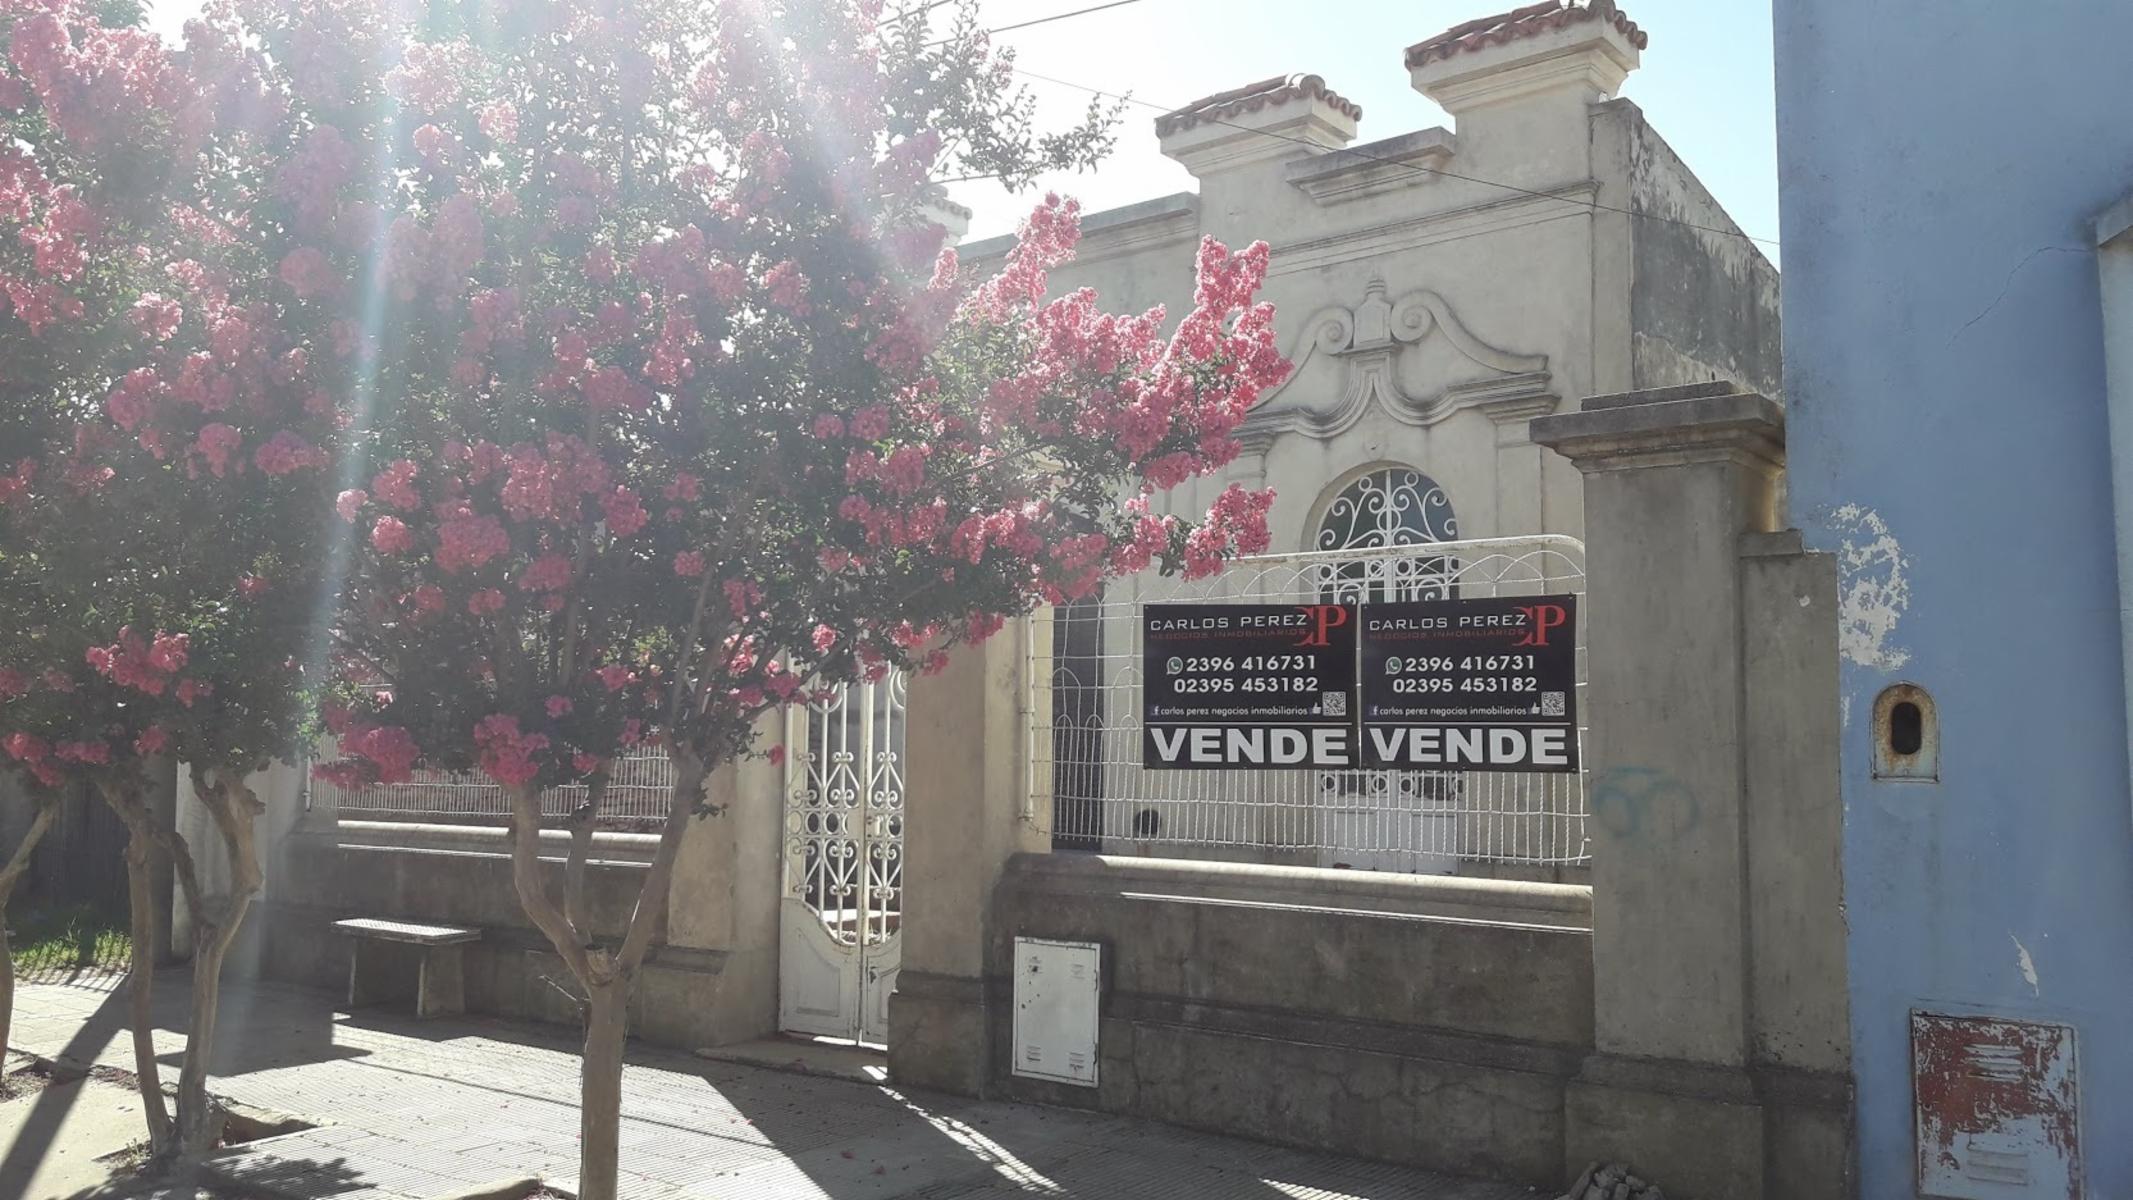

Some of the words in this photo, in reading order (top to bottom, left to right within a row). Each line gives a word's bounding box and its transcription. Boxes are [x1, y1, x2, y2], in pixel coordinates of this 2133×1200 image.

[1150, 617, 1229, 631] CARLOS
[1240, 614, 1307, 627] PEREZ
[1369, 617, 1448, 631] CARLOS
[1459, 614, 1526, 627] PEREZ
[1186, 656, 1235, 672] 2396
[1241, 655, 1316, 671] 416731
[1405, 656, 1454, 672] 2396
[1460, 655, 1535, 671] 416731
[1174, 678, 1235, 693] 02395
[1241, 677, 1318, 692] 453182
[1393, 678, 1453, 693] 02395
[1460, 677, 1537, 692] 453182
[1161, 706, 1185, 716] carlos
[1186, 707, 1209, 717] perez
[1211, 706, 1249, 717] negocios
[1251, 706, 1308, 716] inmobiliarios
[1380, 706, 1404, 716] carlos
[1405, 707, 1428, 717] perez
[1430, 706, 1468, 717] negocios
[1470, 706, 1527, 716] inmobiliarios
[1150, 728, 1349, 765] VENDE
[1369, 728, 1568, 765] VENDE
